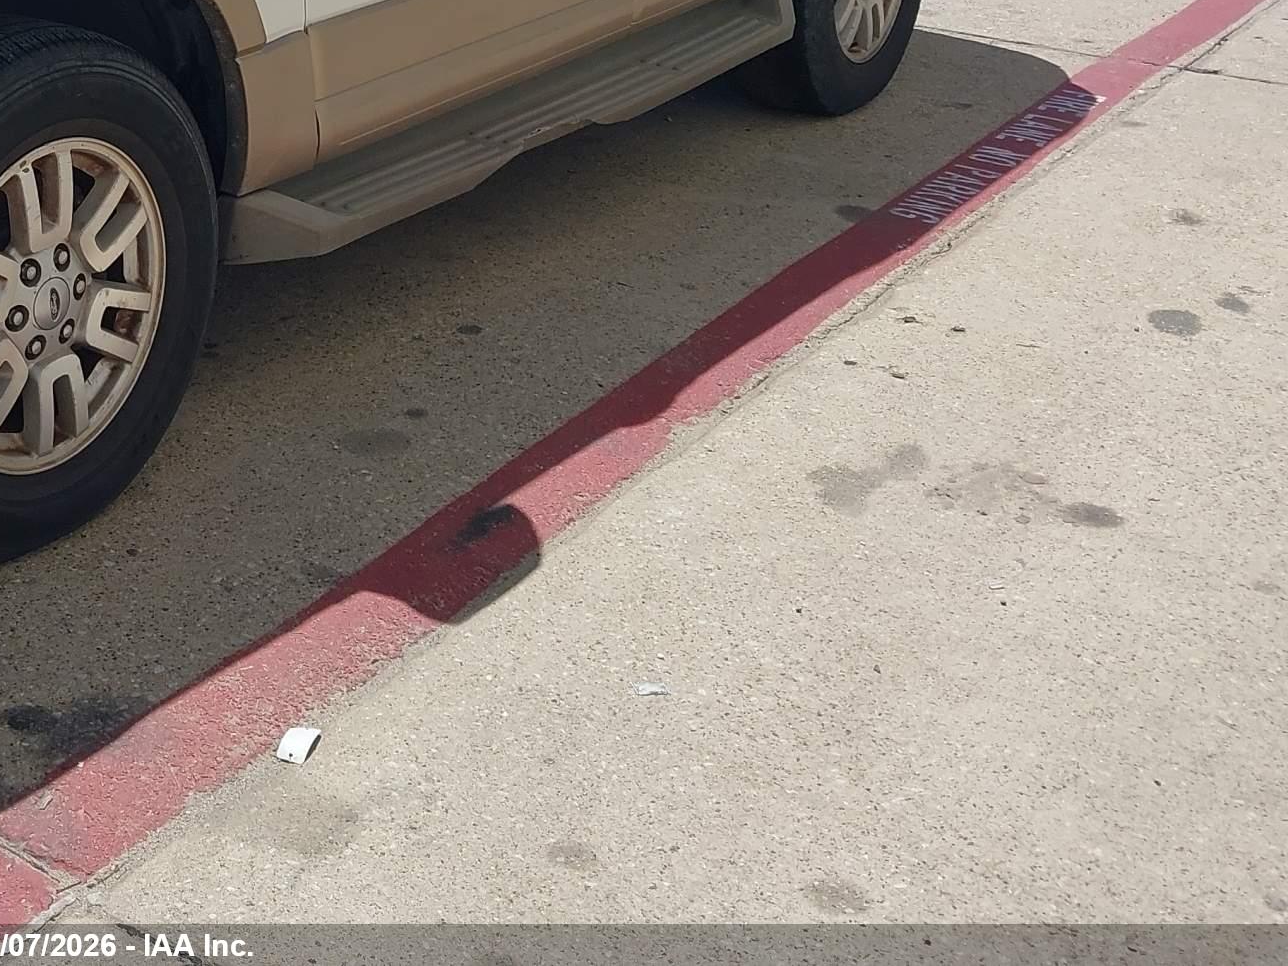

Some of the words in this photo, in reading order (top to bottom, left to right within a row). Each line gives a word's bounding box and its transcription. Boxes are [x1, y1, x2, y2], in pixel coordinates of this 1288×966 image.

[1036, 89, 1108, 117] FIRE
[995, 114, 1073, 147] LANE
[968, 145, 1031, 167] NO
[888, 163, 1003, 224] PARKING
